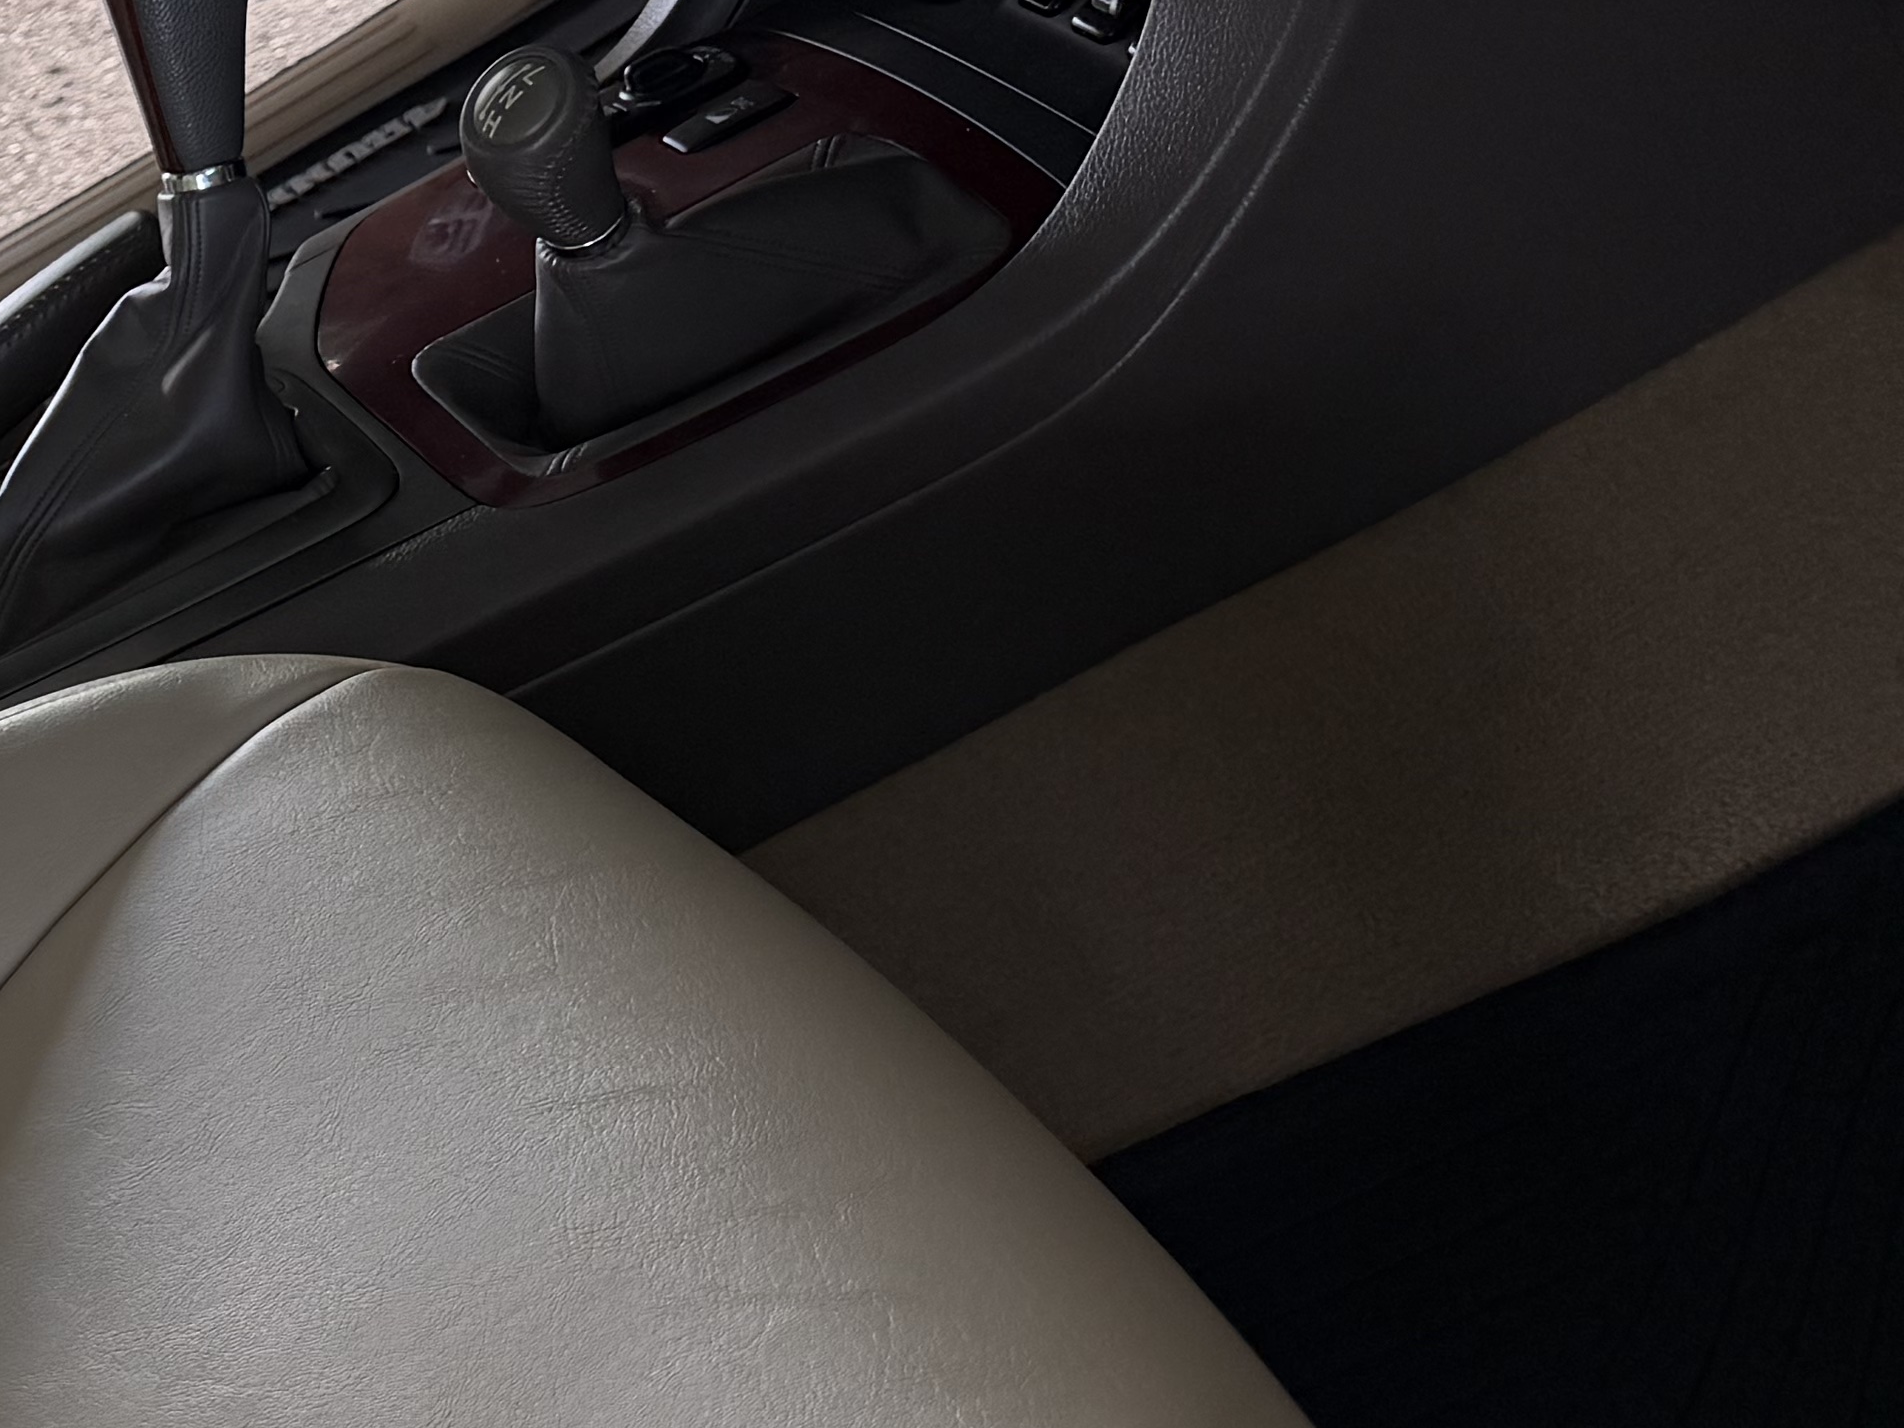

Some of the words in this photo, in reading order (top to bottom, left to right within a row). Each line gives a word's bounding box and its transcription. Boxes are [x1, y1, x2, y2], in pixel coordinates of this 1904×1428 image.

[522, 65, 546, 86] L
[498, 84, 524, 110] N
[482, 110, 503, 139] H
